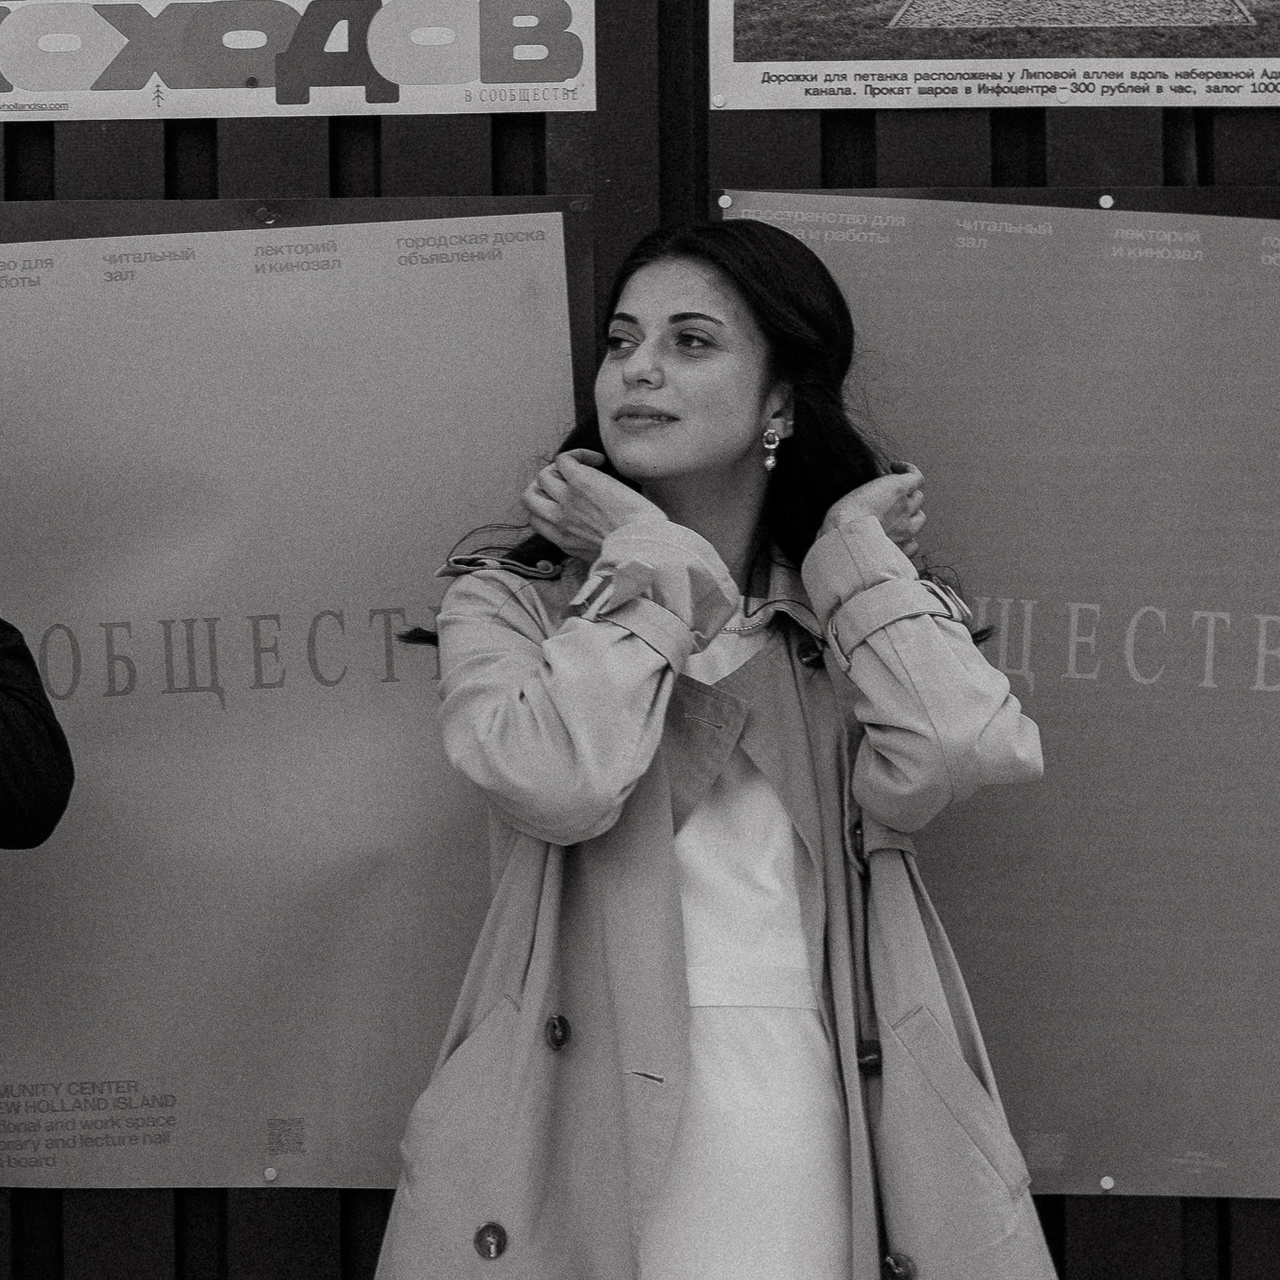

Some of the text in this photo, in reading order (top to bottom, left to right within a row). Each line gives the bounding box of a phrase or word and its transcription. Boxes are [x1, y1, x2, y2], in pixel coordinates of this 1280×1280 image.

[761, 72, 817, 84] Дорожки
[824, 74, 847, 82] для
[914, 73, 1002, 81] расположены
[1020, 70, 1076, 79] Липовой
[1131, 72, 1168, 80] вдоль
[1175, 70, 1254, 80] набережной
[864, 84, 911, 96] Прокат
[918, 87, 958, 95] шаров
[978, 84, 1056, 95] Инфоцентре
[1070, 82, 1096, 93] 300
[1101, 83, 1149, 94] рублей
[1170, 85, 1197, 93] час,
[1205, 85, 1242, 93] залог
[871, 213, 906, 227] для
[956, 219, 1053, 235] читальный
[397, 230, 545, 250] городская доска
[956, 237, 988, 248] зал
[103, 248, 196, 264] читальный
[254, 240, 337, 257] лекторий
[22, 258, 54, 271] для
[398, 248, 502, 266] объявлений
[271, 259, 342, 273] кинозал
[104, 270, 134, 282] зал
[67, 1081, 138, 1097] CENTER
[24, 1098, 108, 1113] HOLLAND
[112, 1094, 176, 1110] ISLAND
[45, 1116, 176, 1132] and work space
[45, 1136, 76, 1149] and
